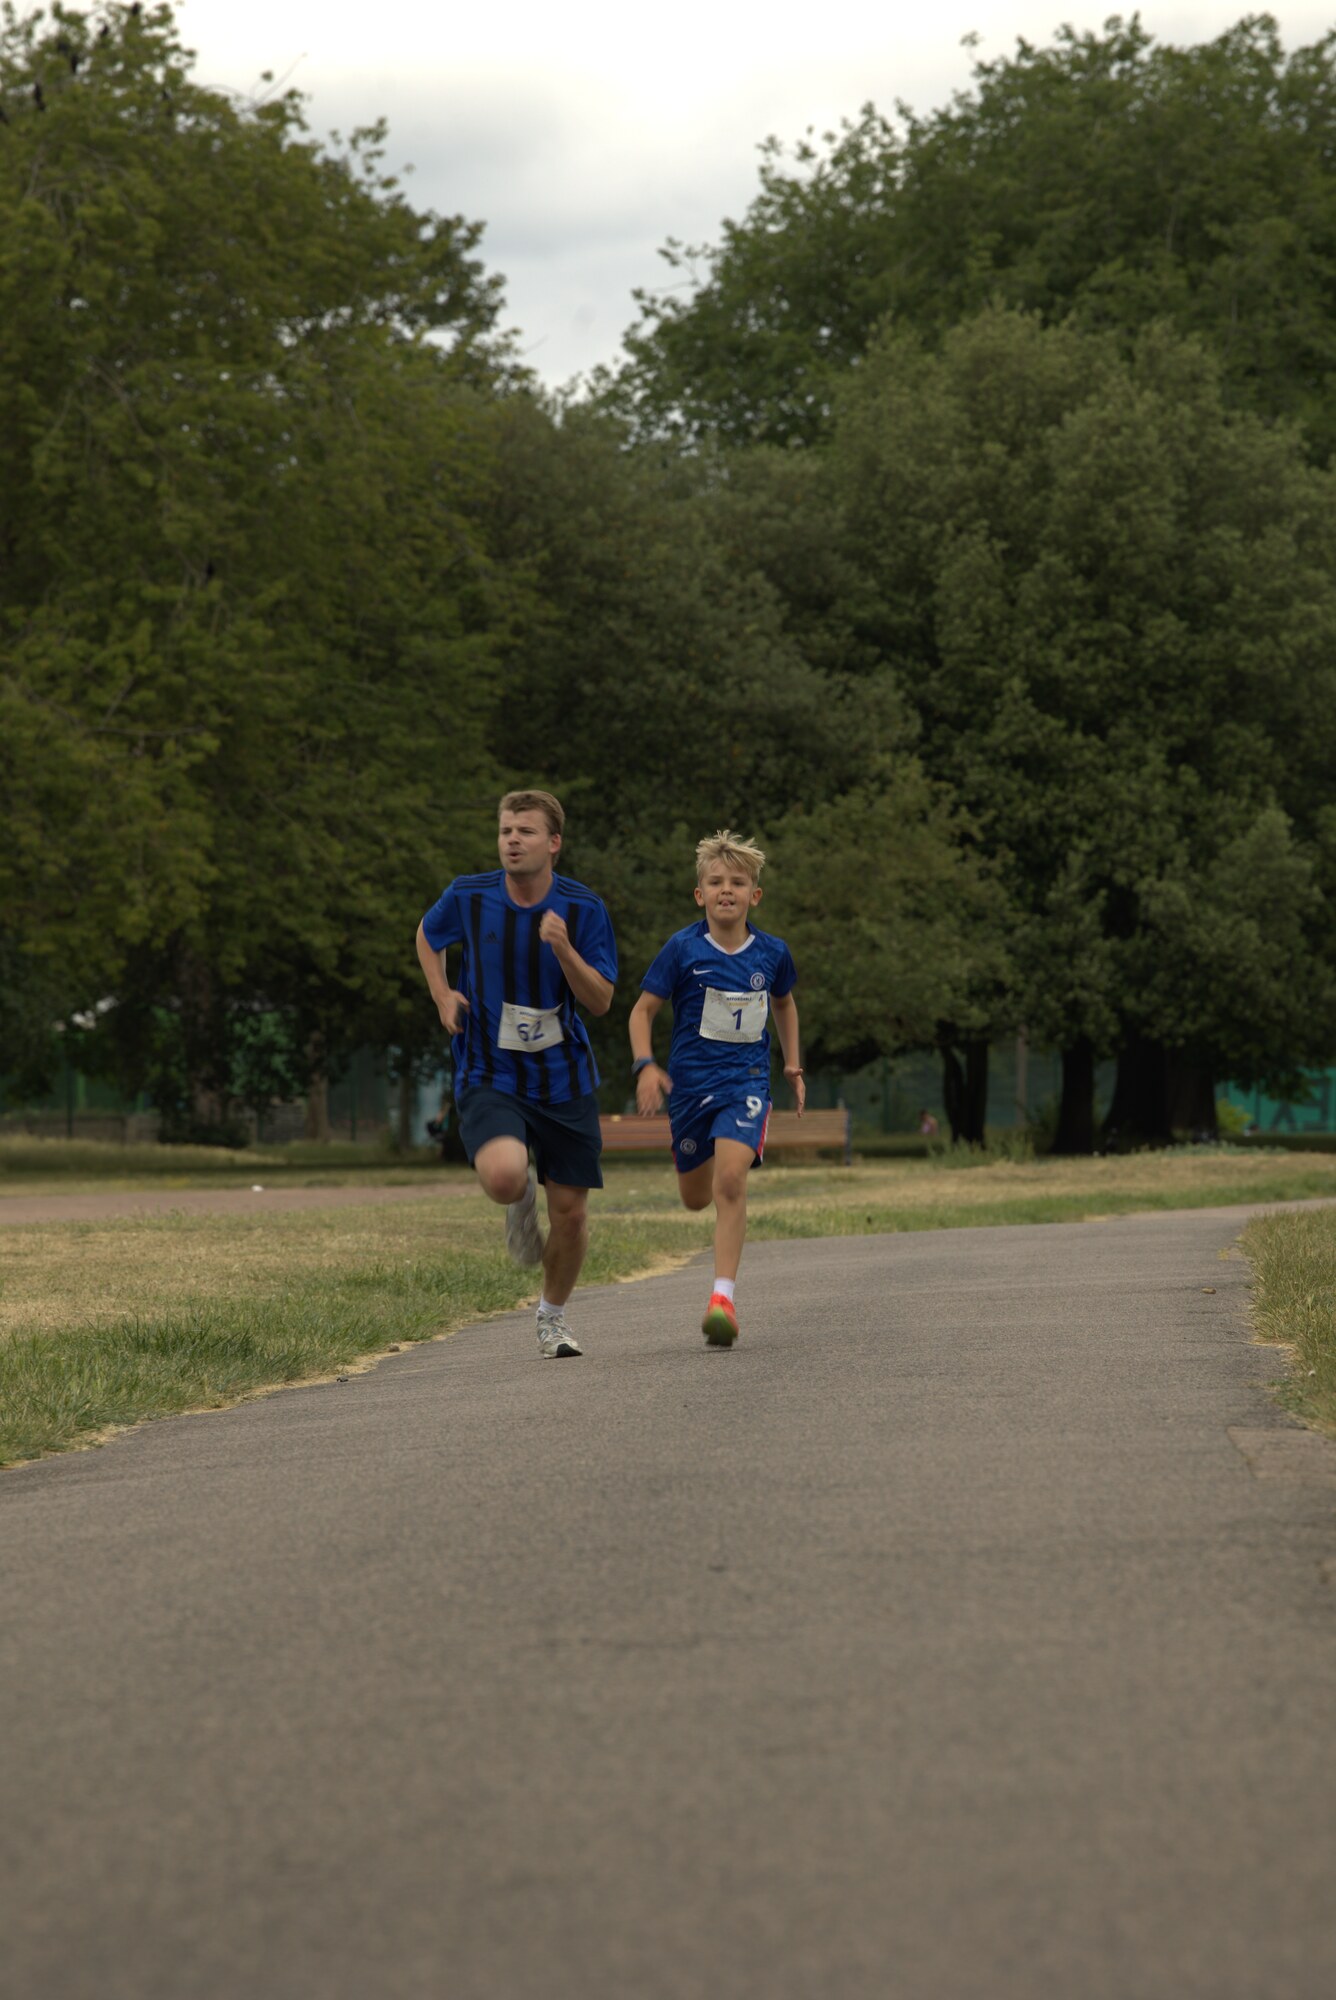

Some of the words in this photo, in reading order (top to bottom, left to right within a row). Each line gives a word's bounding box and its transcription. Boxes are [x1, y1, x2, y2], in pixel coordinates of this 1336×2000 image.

[517, 1020, 545, 1042] 62
[732, 1008, 743, 1031] 1
[746, 1095, 763, 1120] 9
